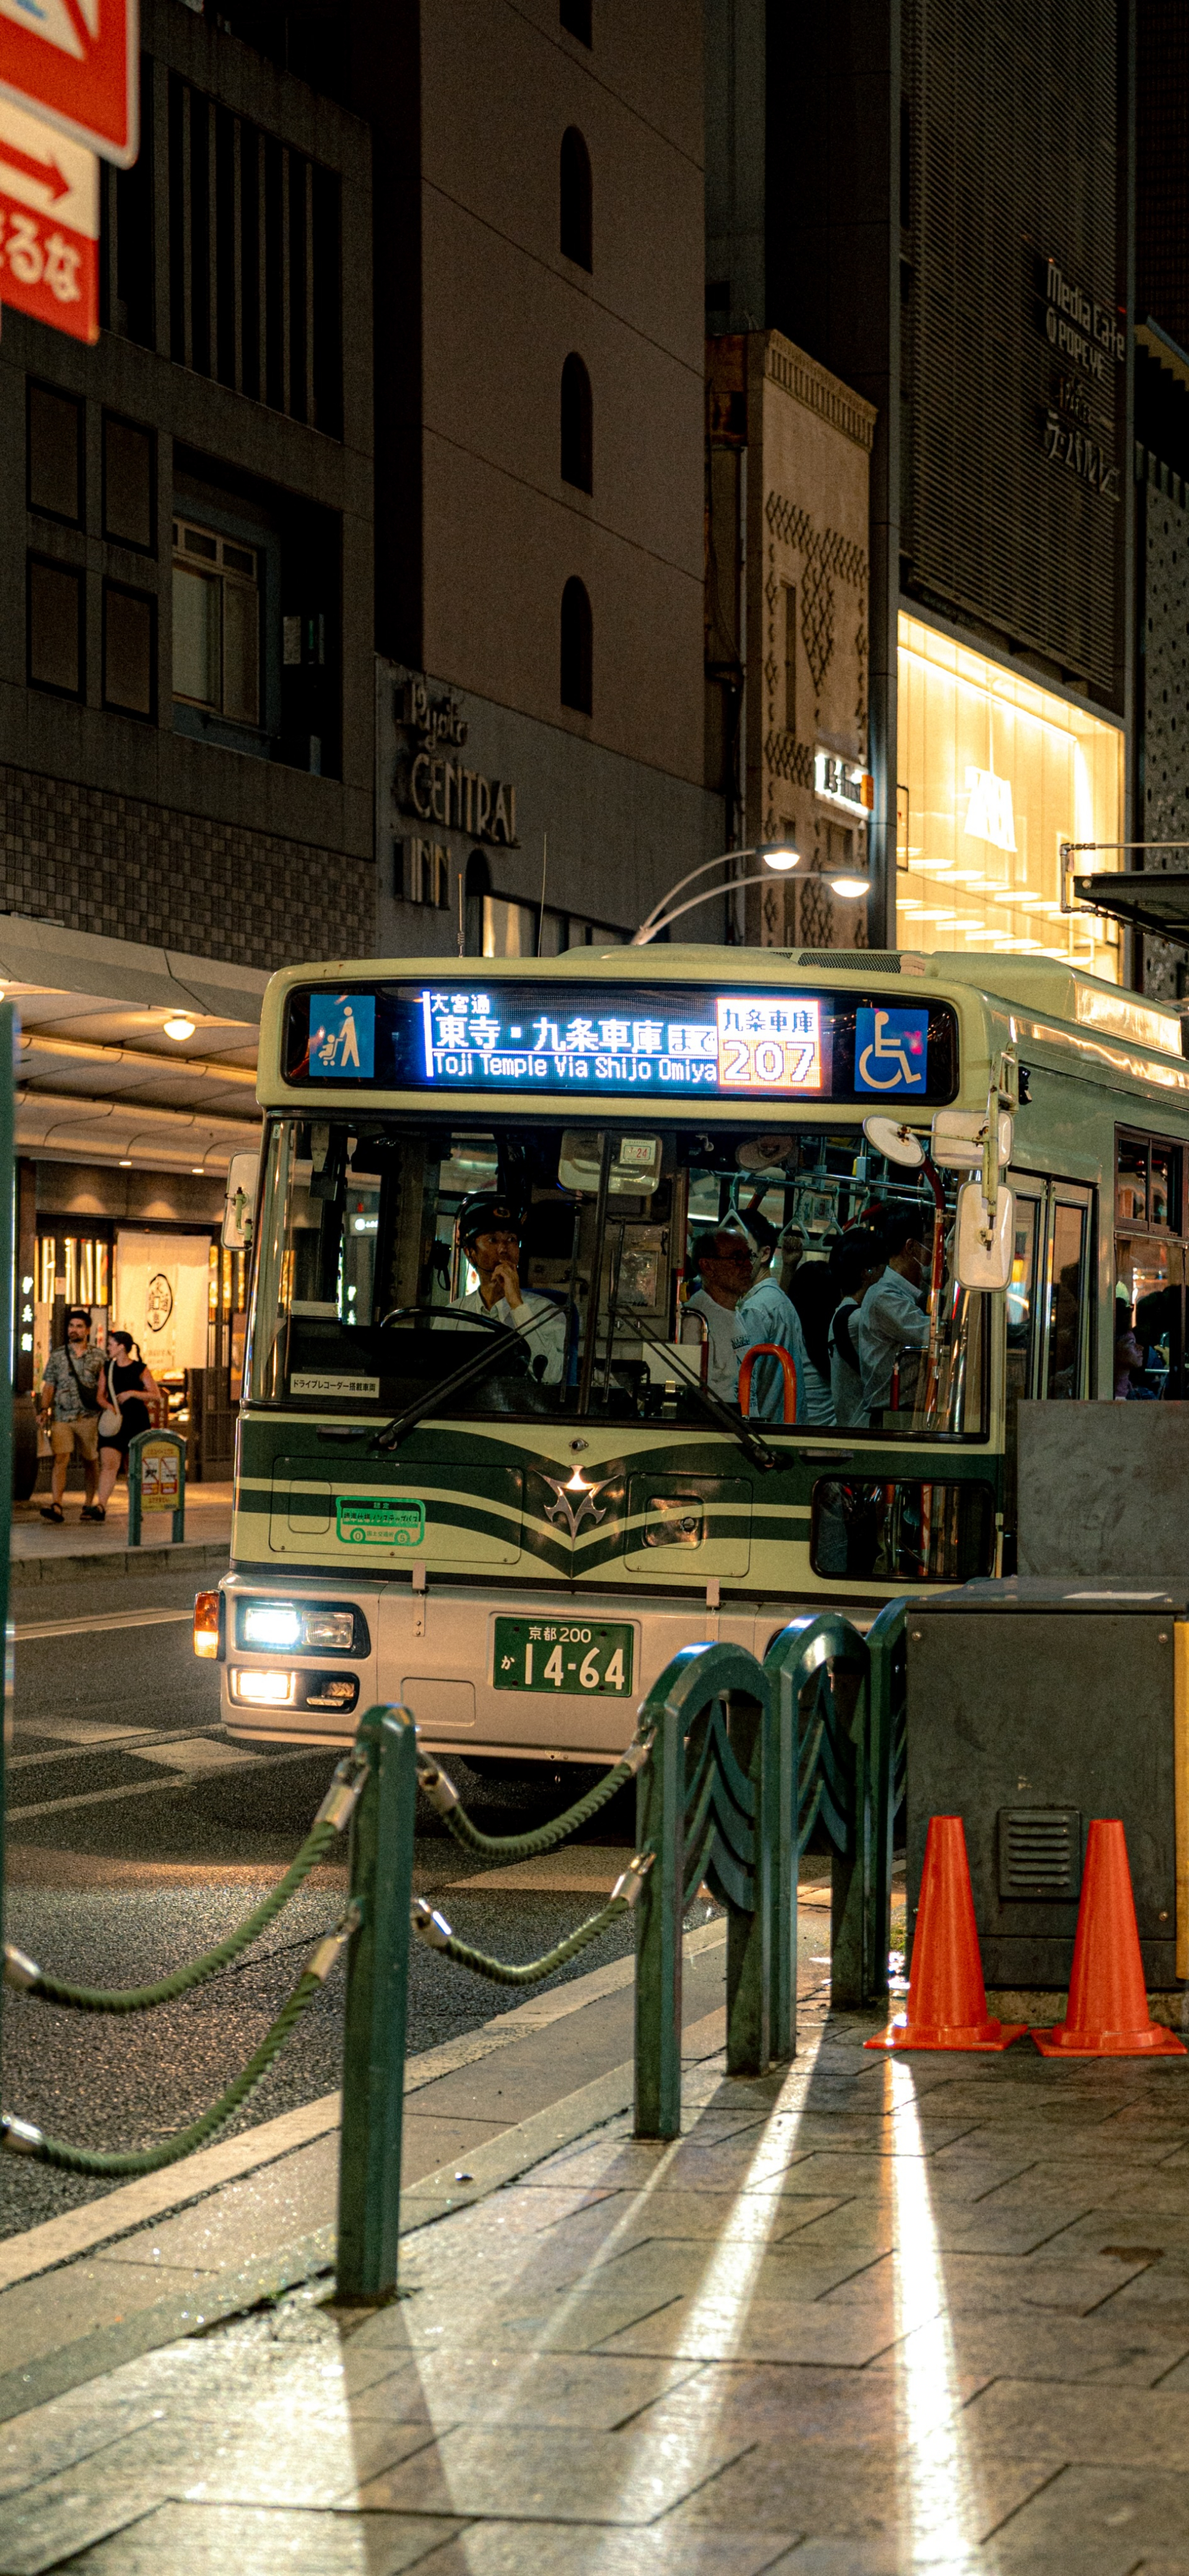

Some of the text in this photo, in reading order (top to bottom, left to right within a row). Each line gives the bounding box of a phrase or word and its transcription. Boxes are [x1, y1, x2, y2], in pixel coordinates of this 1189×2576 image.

[0, 208, 81, 303] るな
[411, 680, 468, 753] Kyoto
[411, 752, 518, 846] CENTRAL
[411, 837, 451, 908] INN
[431, 994, 490, 1014] 大宮通
[723, 1008, 814, 1033] 九条車庫
[433, 1053, 716, 1082] Toji Temple Via Shijo Omiya
[723, 1040, 815, 1082] 207
[636, 1147, 647, 1158] 24
[294, 1379, 377, 1393] ドライブレコーダー搭載車両
[500, 1643, 625, 1690] か 14-64
